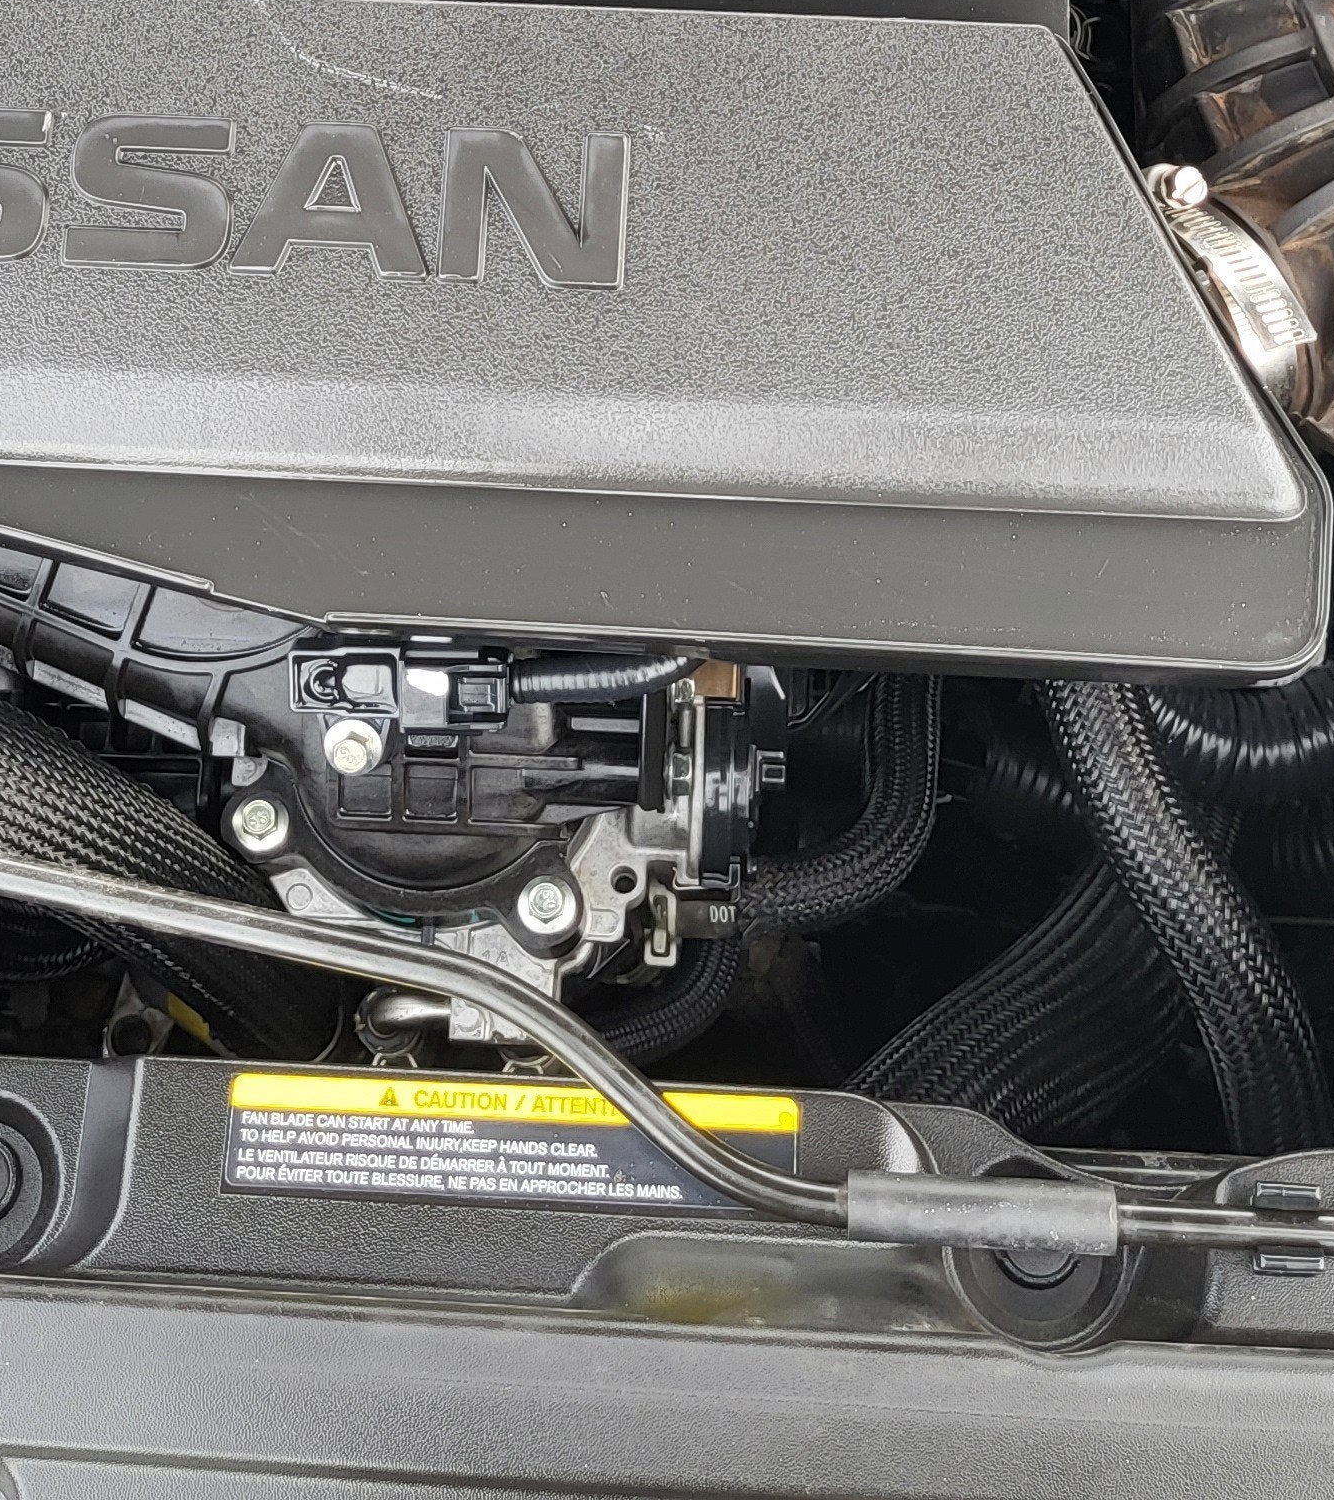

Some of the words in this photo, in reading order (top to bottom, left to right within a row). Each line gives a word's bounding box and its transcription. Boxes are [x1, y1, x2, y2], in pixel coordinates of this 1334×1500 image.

[709, 904, 737, 923] DOT
[413, 1089, 508, 1111] CAUTION
[241, 1110, 268, 1125] FAN
[269, 1112, 315, 1127] BLADE
[317, 1114, 346, 1129] CAN
[348, 1115, 389, 1131] START
[390, 1117, 410, 1131] AT
[410, 1118, 440, 1132] ANY
[440, 1119, 475, 1135] TIME.
[239, 1128, 259, 1143] TO
[261, 1129, 297, 1145] HELP
[297, 1131, 339, 1146] AVOID
[341, 1133, 414, 1149] PERSONAL
[499, 1140, 548, 1156] HANDS
[549, 1142, 598, 1158] CLEAR.
[237, 1148, 255, 1162] LE
[257, 1149, 343, 1167] VENTILATEUR
[344, 1152, 395, 1170] RISQUE
[398, 1154, 418, 1170] DE
[419, 1152, 496, 1174] DÉMARRER
[496, 1155, 508, 1175] À
[508, 1159, 546, 1176] TOUT
[547, 1161, 610, 1178] MOMENT.
[235, 1165, 276, 1182] POUR
[277, 1163, 324, 1183] ÉVITER
[324, 1169, 370, 1186] TOUTE
[371, 1171, 445, 1191] BLESSURE,
[447, 1175, 468, 1191] NE
[469, 1176, 497, 1192] PAS
[498, 1178, 518, 1192] EN
[521, 1179, 608, 1197] APPROCHER
[608, 1182, 635, 1198] LES
[636, 1184, 684, 1200] MAINS.
